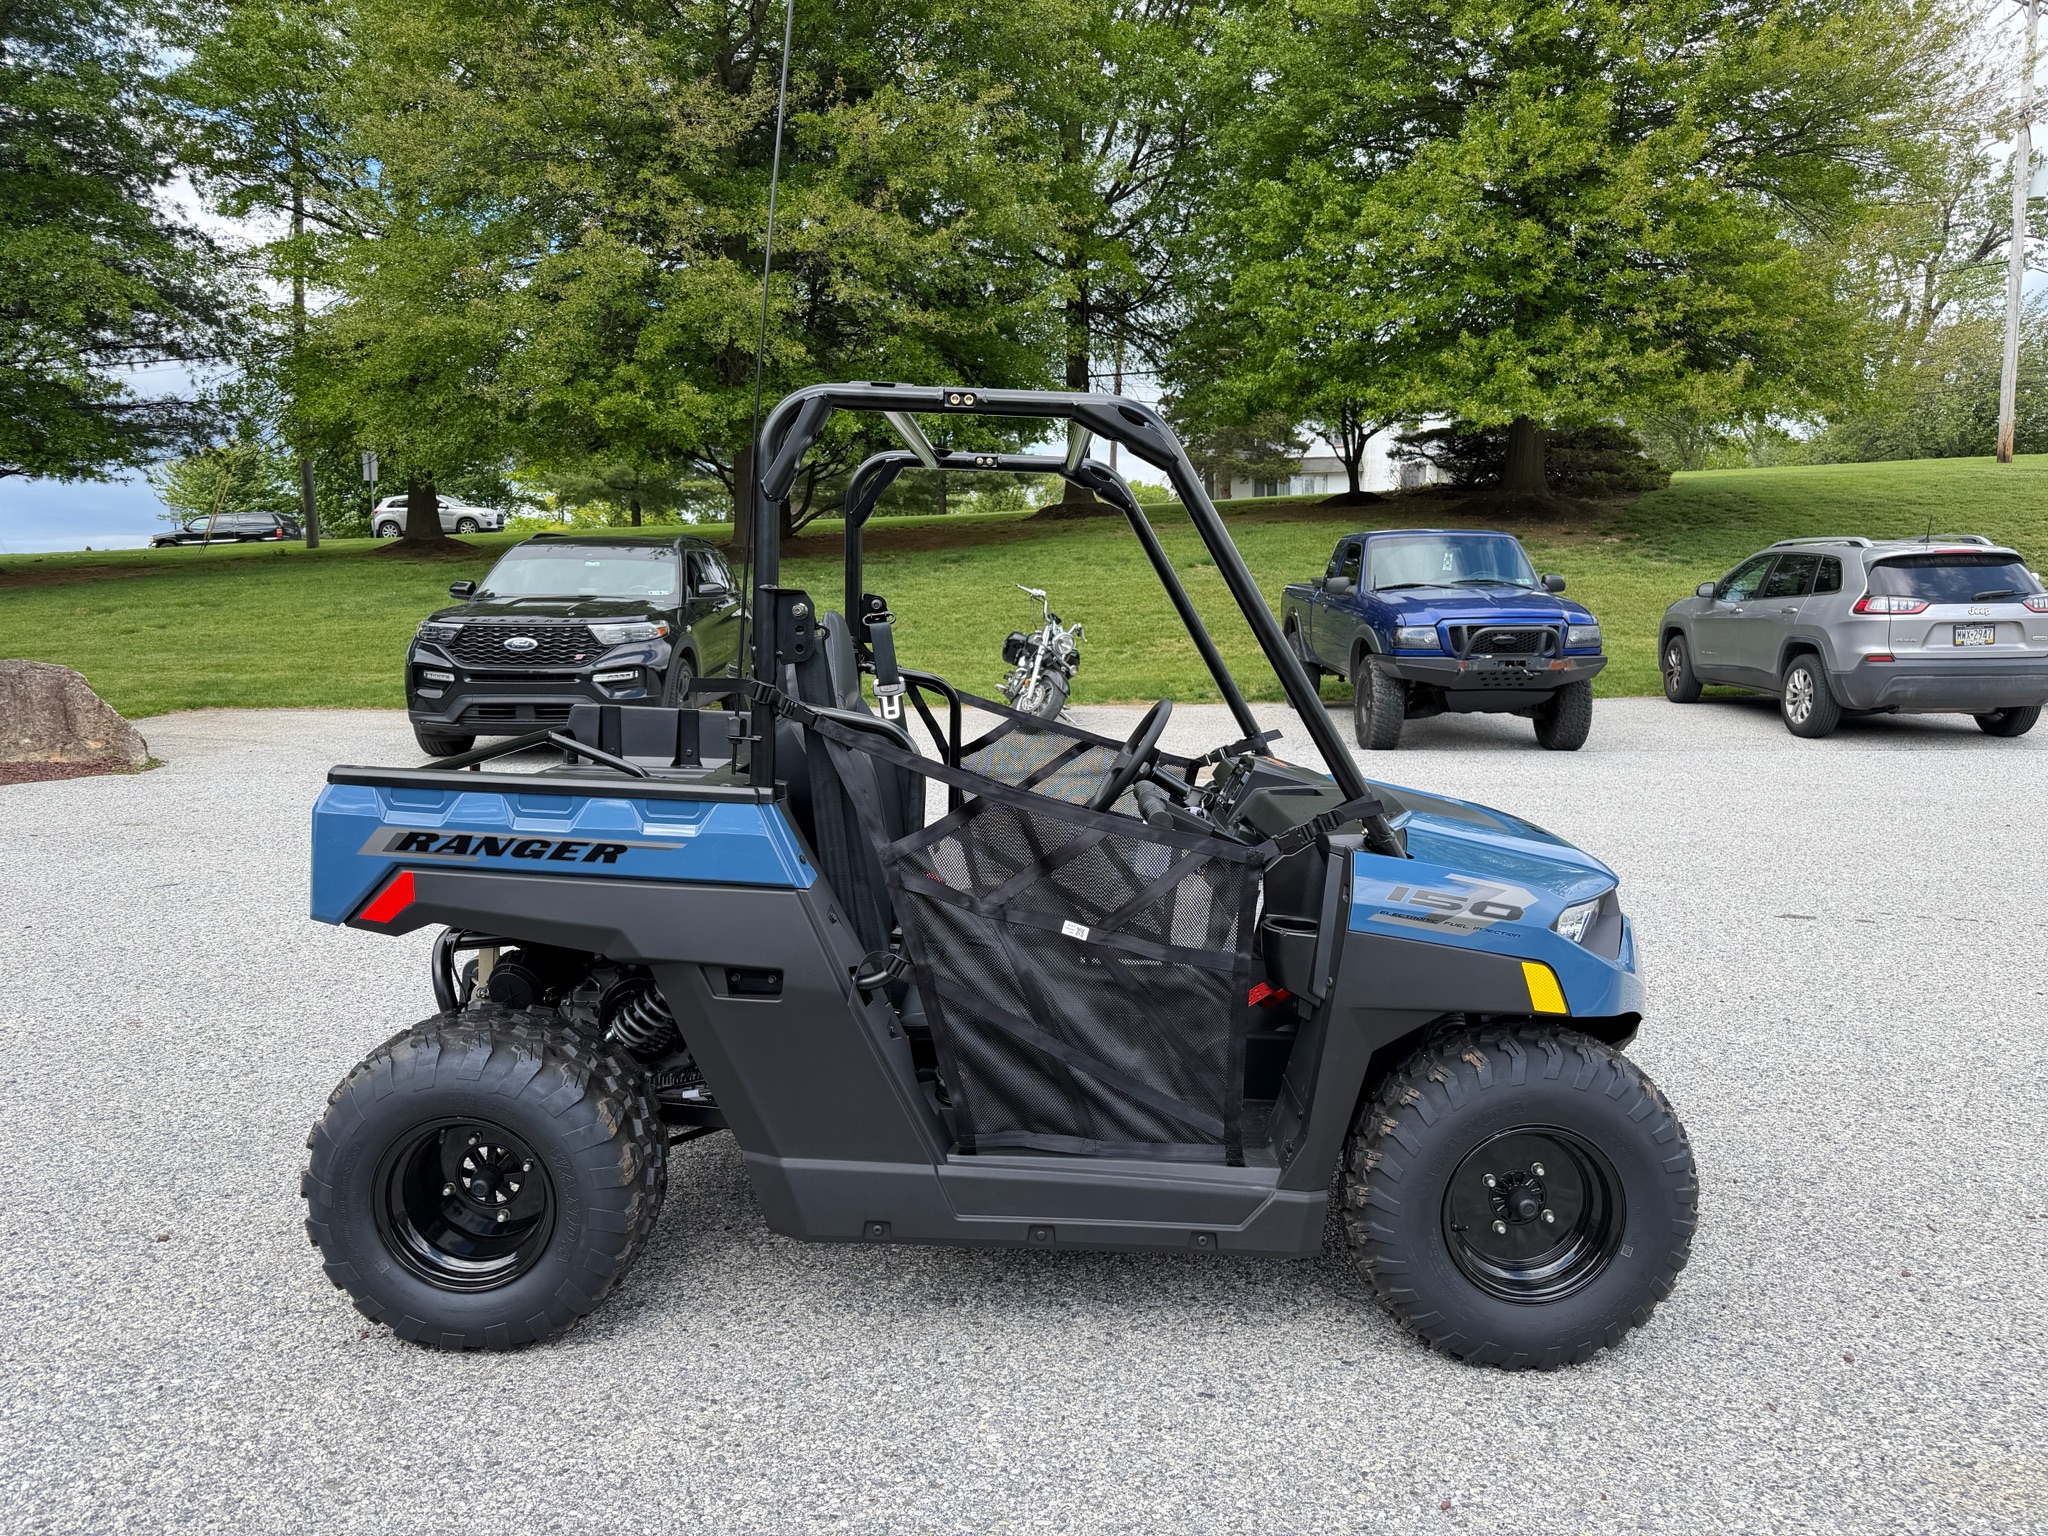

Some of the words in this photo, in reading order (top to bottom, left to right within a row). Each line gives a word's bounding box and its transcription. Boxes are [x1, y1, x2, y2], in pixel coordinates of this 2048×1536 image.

[1967, 606, 1992, 616] Jeep
[394, 831, 628, 864] RANGER
[1386, 885, 1524, 921] 150
[1379, 910, 1440, 924] ELECTRONIC
[1443, 921, 1469, 930] FUEL
[1472, 926, 1522, 938] INJECTION
[1426, 1101, 1526, 1177] WANDA
[547, 1146, 580, 1263] WANDA
